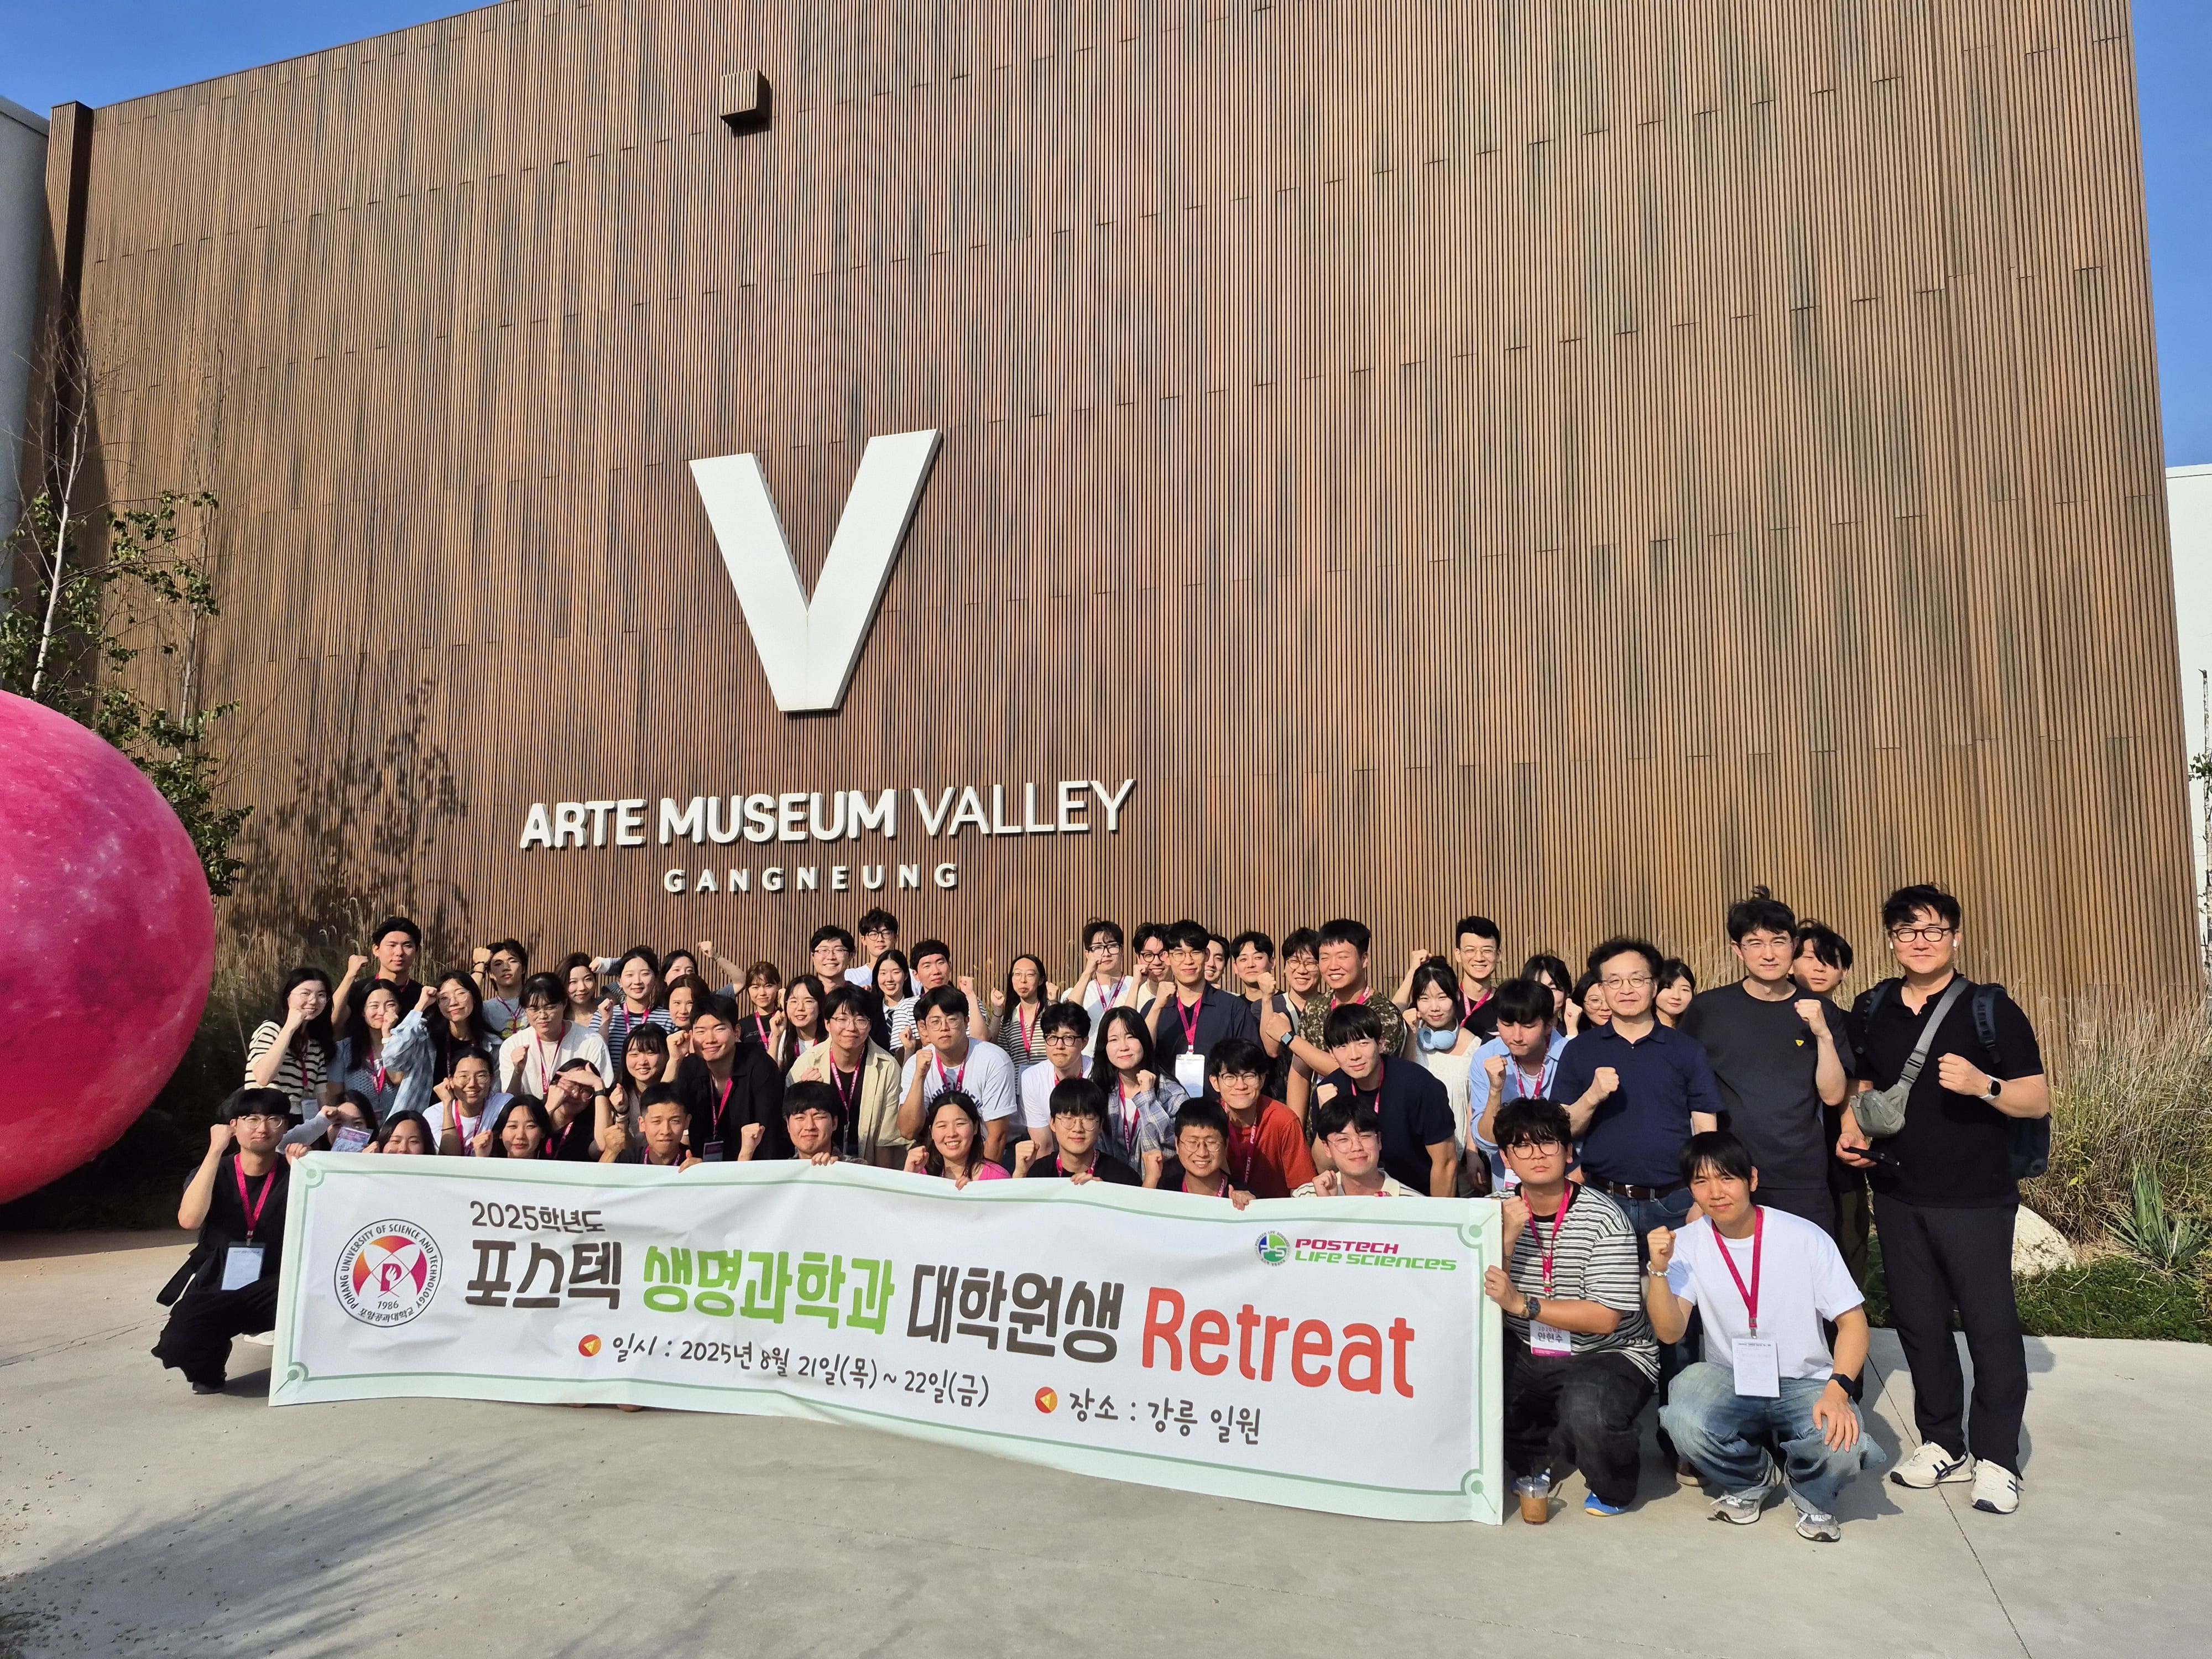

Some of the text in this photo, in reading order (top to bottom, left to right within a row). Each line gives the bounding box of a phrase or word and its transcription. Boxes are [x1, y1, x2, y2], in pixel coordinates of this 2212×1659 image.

[689, 429, 941, 712] V
[519, 779, 1135, 848] ARTE MUSEUM VALLEY
[664, 863, 957, 893] GANGNEUNG
[469, 1200, 607, 1233] 2025학년도
[340, 1223, 439, 1310] POHANG UNIVERSITY OF SCIENCE AND TECHNOLOGY
[357, 1306, 415, 1323] 포항공과대학교
[377, 1300, 400, 1310] 1986
[464, 1239, 1415, 1399] 포스텍 생명과학과 대학원생 Retreat
[612, 1332, 656, 1363] 일시
[680, 1340, 752, 1370] 2025년
[759, 1346, 790, 1378] 8월
[1069, 1387, 1119, 1422] 장소
[1147, 1397, 1198, 1437] 강릉
[1210, 1405, 1261, 1446] 일원
